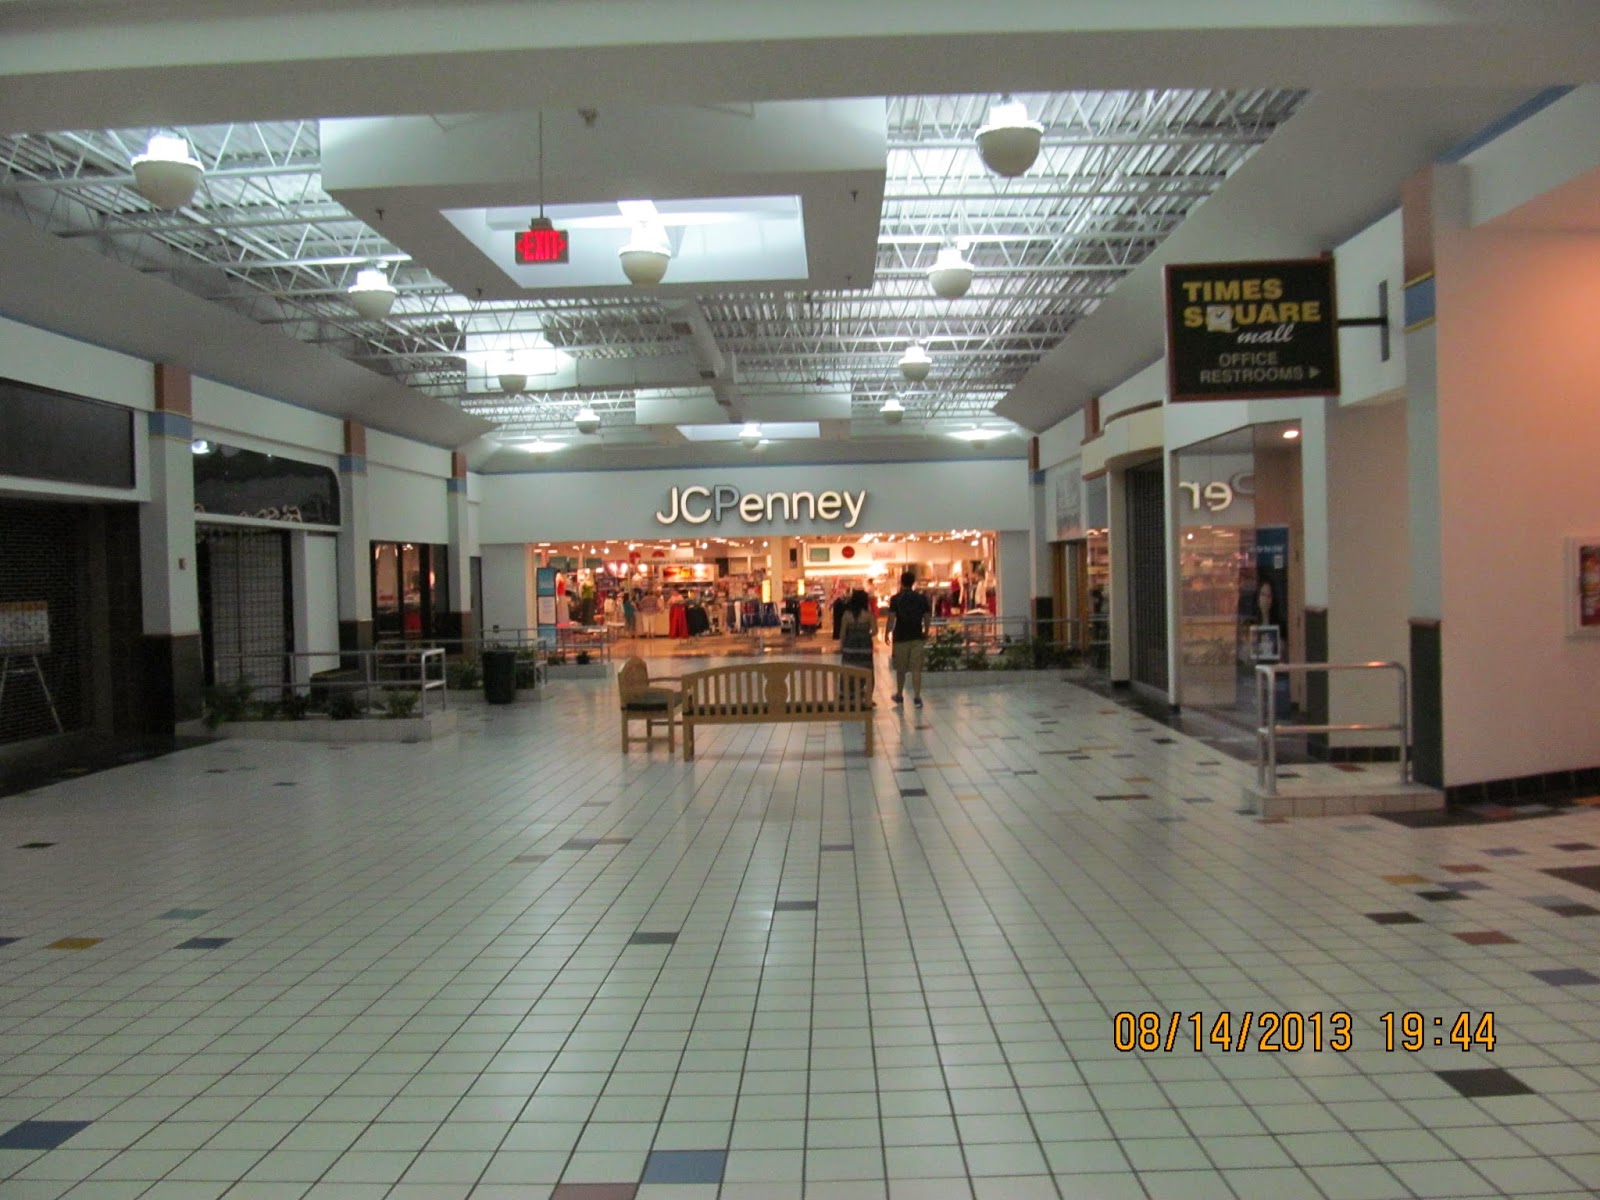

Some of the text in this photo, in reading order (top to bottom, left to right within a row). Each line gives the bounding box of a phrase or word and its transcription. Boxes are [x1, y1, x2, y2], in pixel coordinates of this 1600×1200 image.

[524, 231, 560, 261] EXIT
[1183, 279, 1282, 302] TIMES
[1237, 323, 1294, 343] mall
[1219, 352, 1278, 367] OFFICE
[1200, 366, 1303, 383] RESTROOMS
[655, 484, 867, 528] JCPenney
